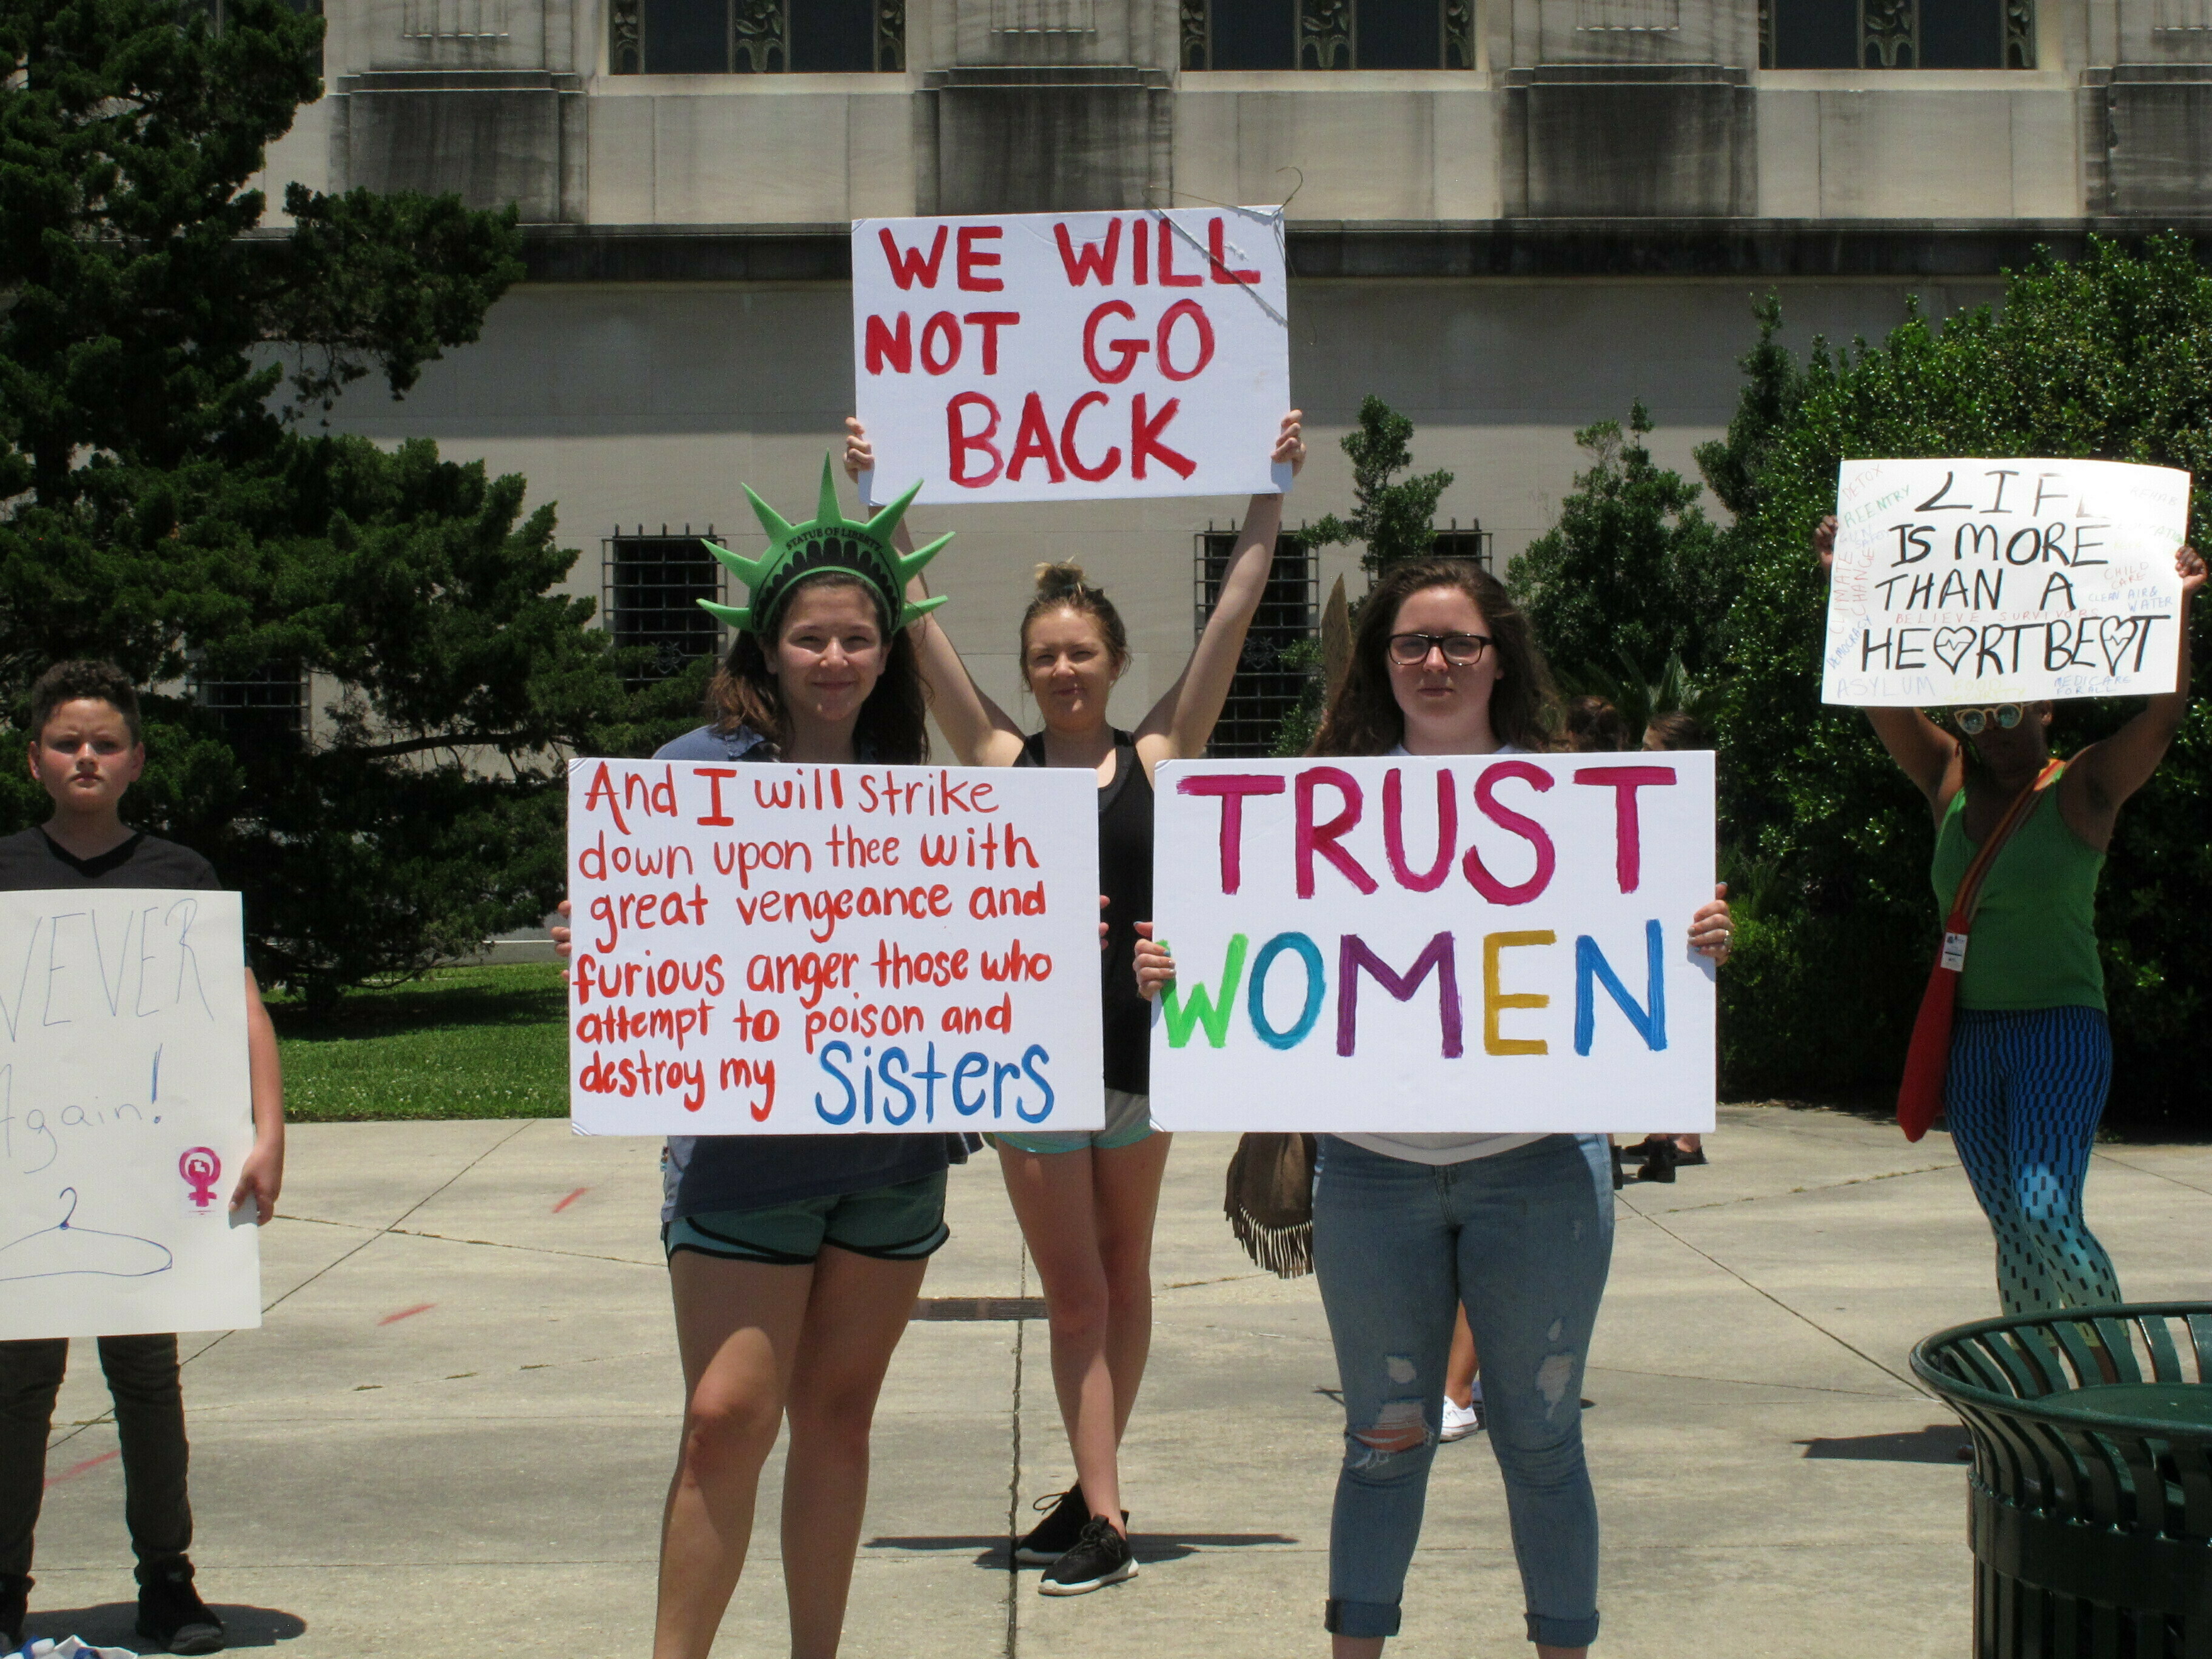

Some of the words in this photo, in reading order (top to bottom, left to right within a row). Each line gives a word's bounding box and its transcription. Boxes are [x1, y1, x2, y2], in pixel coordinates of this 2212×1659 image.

[878, 225, 1005, 292] WE
[1053, 217, 1261, 287] WILL
[865, 311, 1020, 376] NOT
[1083, 298, 1215, 384] GO
[946, 390, 1197, 489] BACK
[1842, 464, 1883, 501] DETOX
[1844, 484, 1909, 528] REENTRY
[825, 527, 840, 536] OF
[1889, 523, 1936, 568] IS
[1954, 522, 2111, 568] MORE
[1829, 552, 1852, 634] CLIMATE
[1851, 548, 1874, 616] CHANGE
[1875, 568, 2003, 611] THAN
[2039, 572, 2076, 611] A
[2104, 561, 2149, 579] CHILD
[1895, 611, 1979, 624] BELIEVE
[1999, 608, 2099, 622] SURVIVORS
[2128, 596, 2173, 613] WATER
[1837, 675, 1936, 699] ASYLUM
[585, 762, 677, 835] And
[692, 768, 737, 826] I
[754, 768, 844, 810] will
[579, 830, 695, 881] down
[714, 836, 813, 889] upon
[825, 824, 900, 869] thee
[920, 822, 1040, 871] with
[1176, 759, 1677, 907] TRUST
[590, 883, 709, 953] great
[736, 883, 953, 943] vengeance
[970, 880, 1046, 920] and
[572, 950, 725, 1005] furious
[746, 953, 859, 1009] anger
[871, 939, 970, 987] those
[980, 939, 1052, 982] who
[1157, 918, 1668, 1059] WOMEN
[576, 997, 715, 1050] attempt
[733, 999, 780, 1042] to
[805, 991, 924, 1053] poison
[942, 991, 1012, 1034] and
[579, 1049, 705, 1112] destroy
[720, 1055, 775, 1122] my
[814, 1039, 1056, 1127] Sisters
